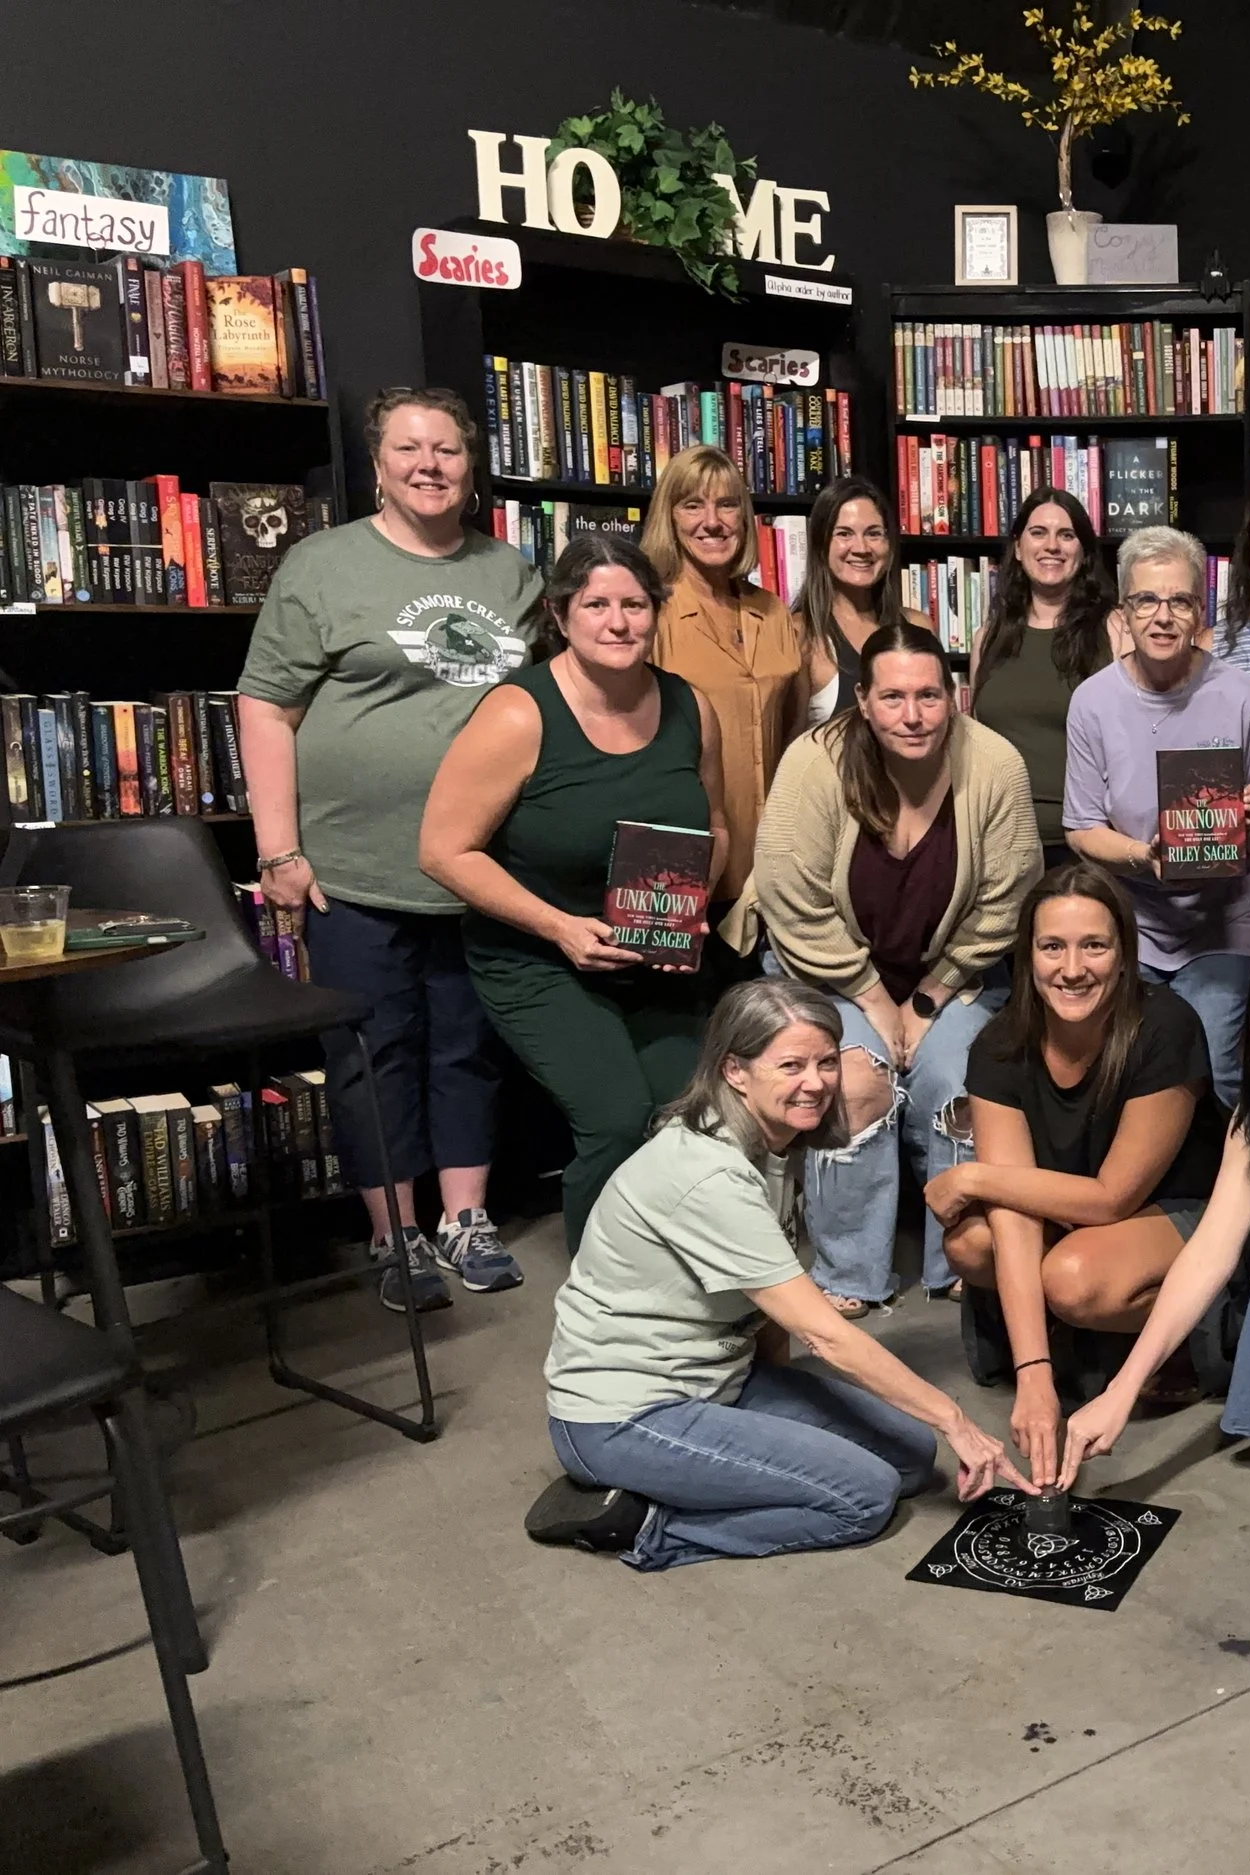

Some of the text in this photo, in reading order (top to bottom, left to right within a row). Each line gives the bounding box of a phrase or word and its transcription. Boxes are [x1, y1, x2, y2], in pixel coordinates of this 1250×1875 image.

[467, 129, 836, 272] HOME
[20, 191, 155, 251] fantasy
[419, 232, 509, 286] Scaries
[33, 264, 112, 282] NEIL GAIMAN
[795, 283, 814, 295] order
[816, 286, 826, 300] by
[827, 288, 850, 300] author
[224, 315, 256, 328] Rose
[212, 328, 270, 342] Labyrinth
[59, 354, 100, 366] NORSE
[728, 350, 810, 378] Scaries
[1163, 345, 1173, 374] SUSPECTS
[41, 367, 119, 380] MYTHOLOGY
[485, 374, 494, 394] NO
[561, 381, 569, 399] DAVID
[487, 399, 496, 429] EXIT
[580, 403, 588, 433] BALDACCI
[609, 387, 619, 445] DAVID BALDACCI
[1109, 471, 1163, 479] FLICKER
[1108, 502, 1164, 515] DARK
[576, 516, 635, 532] the other
[206, 528, 217, 561] SERPENT
[34, 561, 42, 584] BLOOD
[396, 594, 514, 635] SYCAMORE CREEK
[435, 662, 499, 683] CROCS
[158, 743, 167, 775] WARRIOR
[178, 739, 187, 760] BREAK
[231, 759, 242, 779] HEIR
[47, 773, 58, 815] SWORD
[161, 776, 169, 794] KING
[1196, 799, 1207, 808] THE
[1165, 808, 1238, 830] UNKNOWN
[1168, 845, 1238, 862] RILEY SAGER
[653, 882, 664, 891] THE
[615, 888, 699, 916] UNKNOWN
[613, 926, 692, 949] RILEY SAGER
[143, 1131, 158, 1208] EMPIRE GRASS
[154, 1128, 171, 1210] TAD WILLIAMS
[52, 1196, 61, 1225] WEXLER
[60, 1194, 70, 1225] DJANGO
[1005, 1578, 1025, 1587] NO
